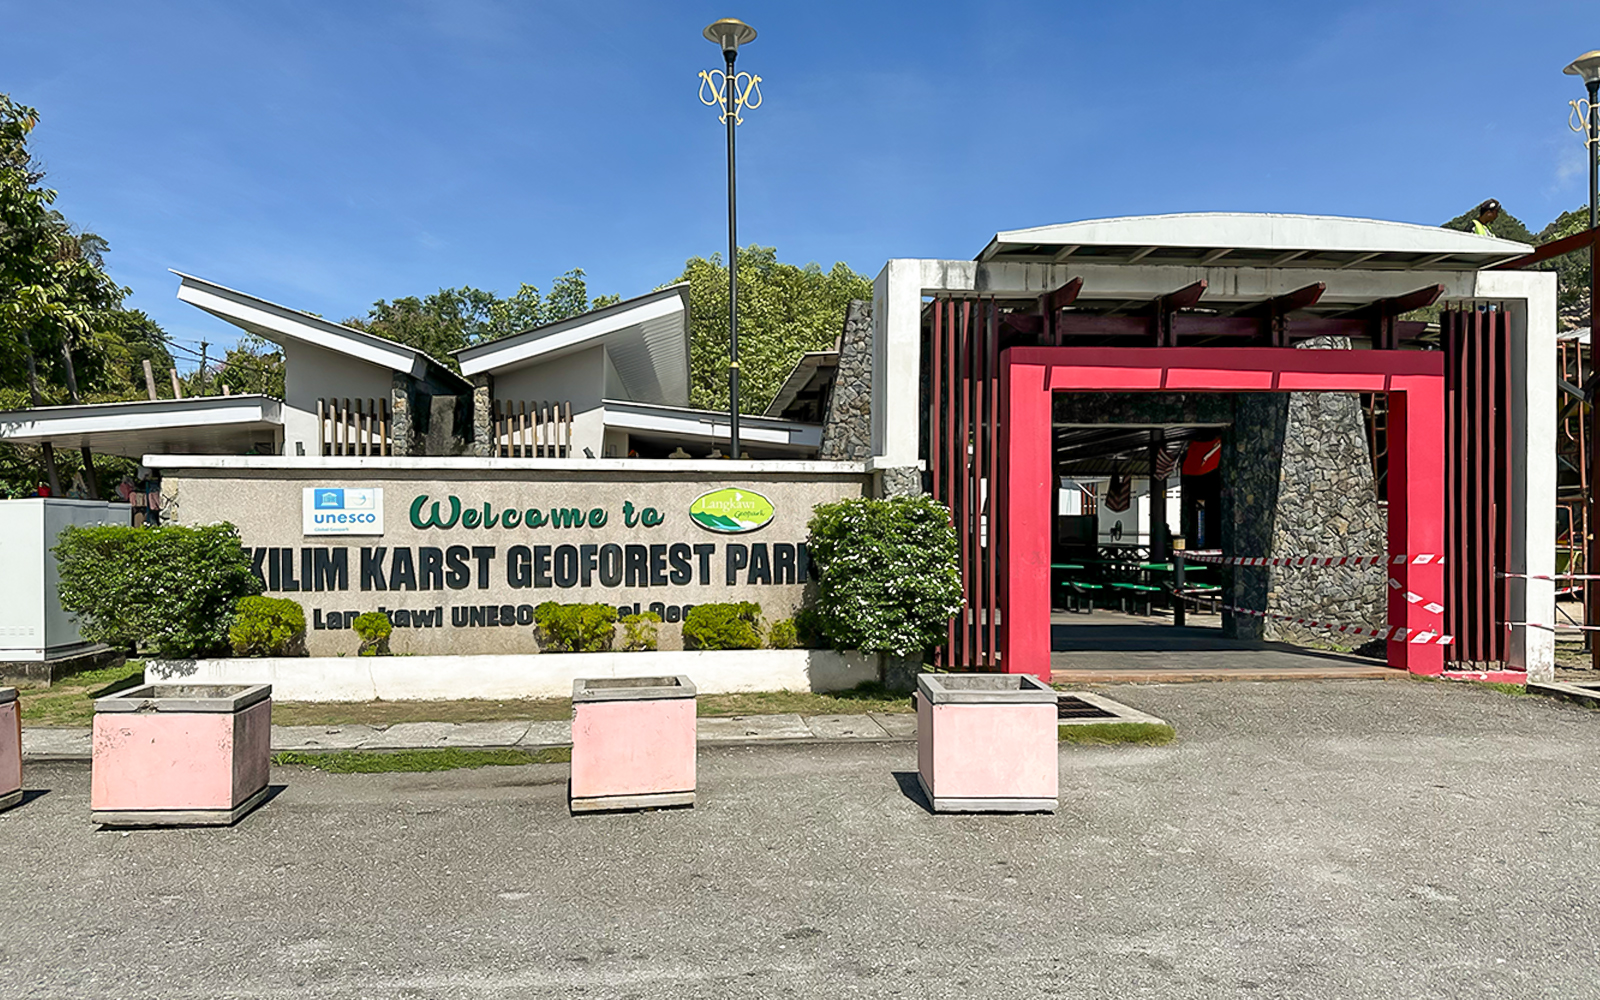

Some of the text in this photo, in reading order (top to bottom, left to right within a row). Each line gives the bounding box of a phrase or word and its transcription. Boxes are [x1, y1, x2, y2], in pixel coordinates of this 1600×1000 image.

[409, 494, 665, 529] Welcome to
[700, 497, 755, 512] Langkawi
[314, 513, 376, 523] unesco
[240, 547, 348, 591] KILIM
[360, 545, 496, 591] KARST
[506, 543, 715, 589] GEOFOREST
[313, 606, 443, 630] Lankawi
